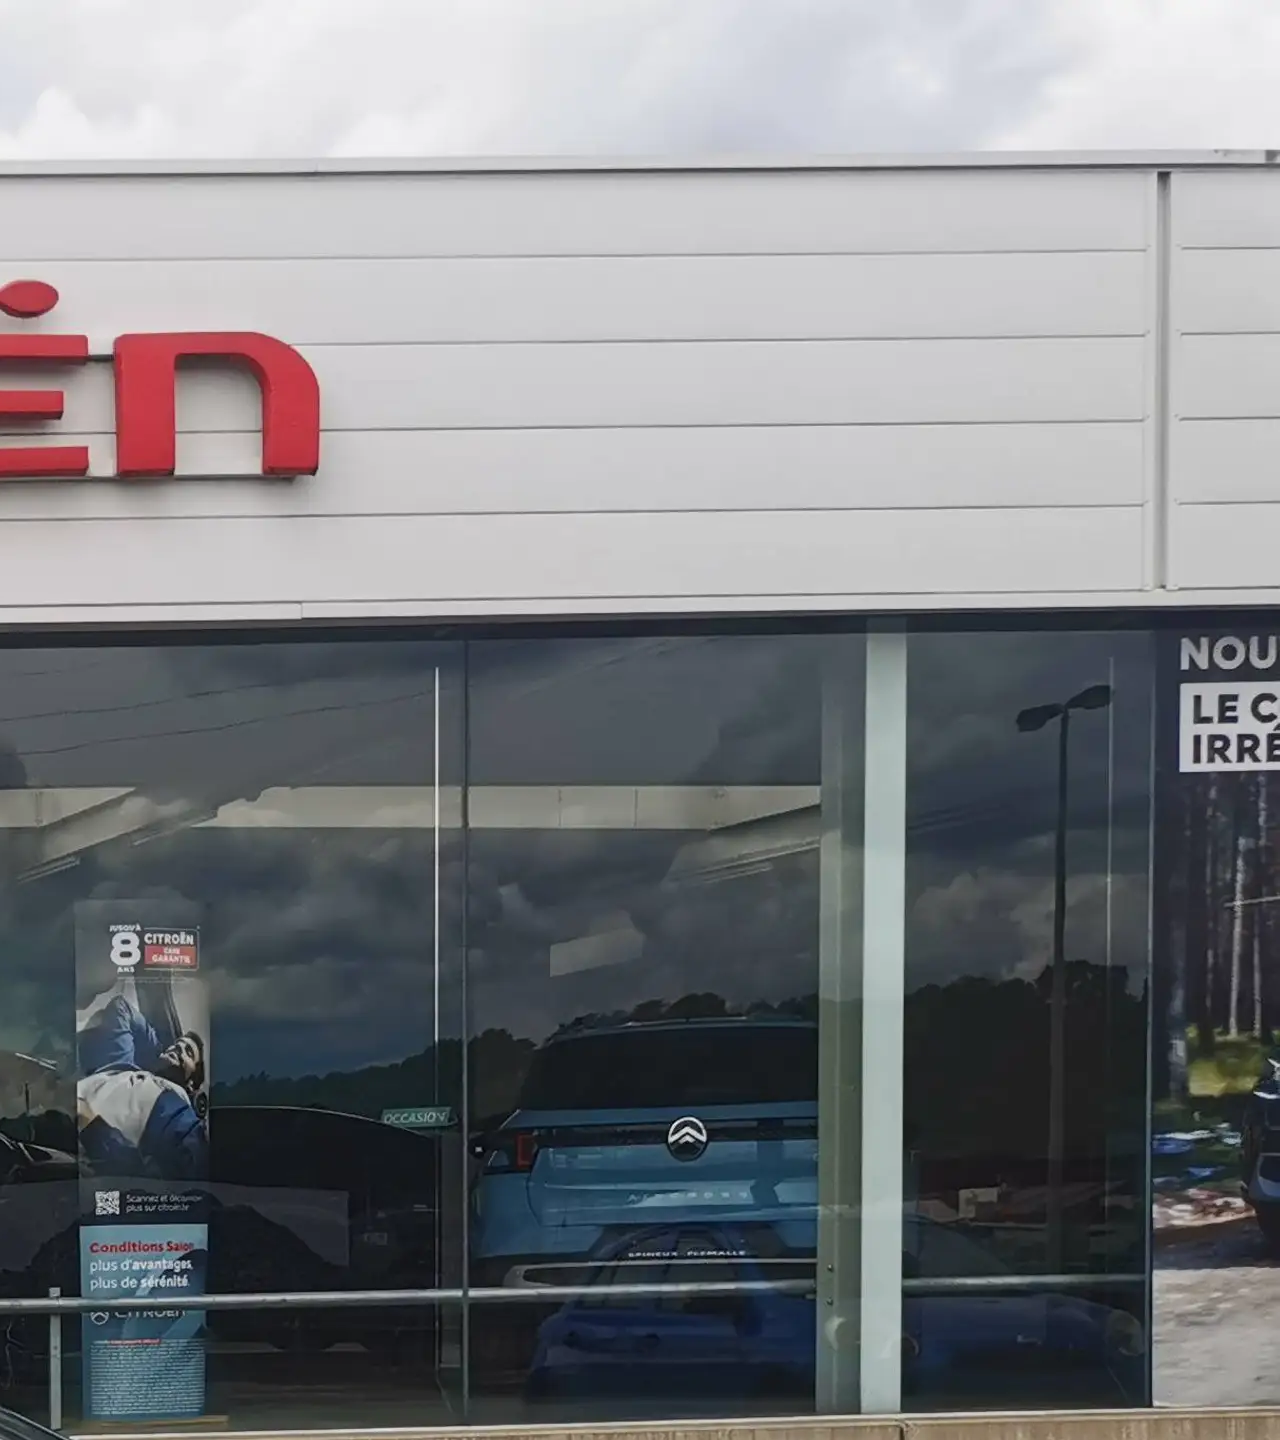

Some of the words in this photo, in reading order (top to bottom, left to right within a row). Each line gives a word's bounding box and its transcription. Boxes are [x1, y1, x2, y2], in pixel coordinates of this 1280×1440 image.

[1180, 635, 1277, 670] NOU
[1193, 693, 1239, 724] LE
[1250, 692, 1278, 723] C
[143, 932, 195, 945] CITROËN
[110, 932, 141, 966] 8
[89, 1241, 164, 1253] Conditions
[90, 1259, 118, 1274] plus
[90, 1276, 117, 1291] plus
[121, 1276, 138, 1288] de
